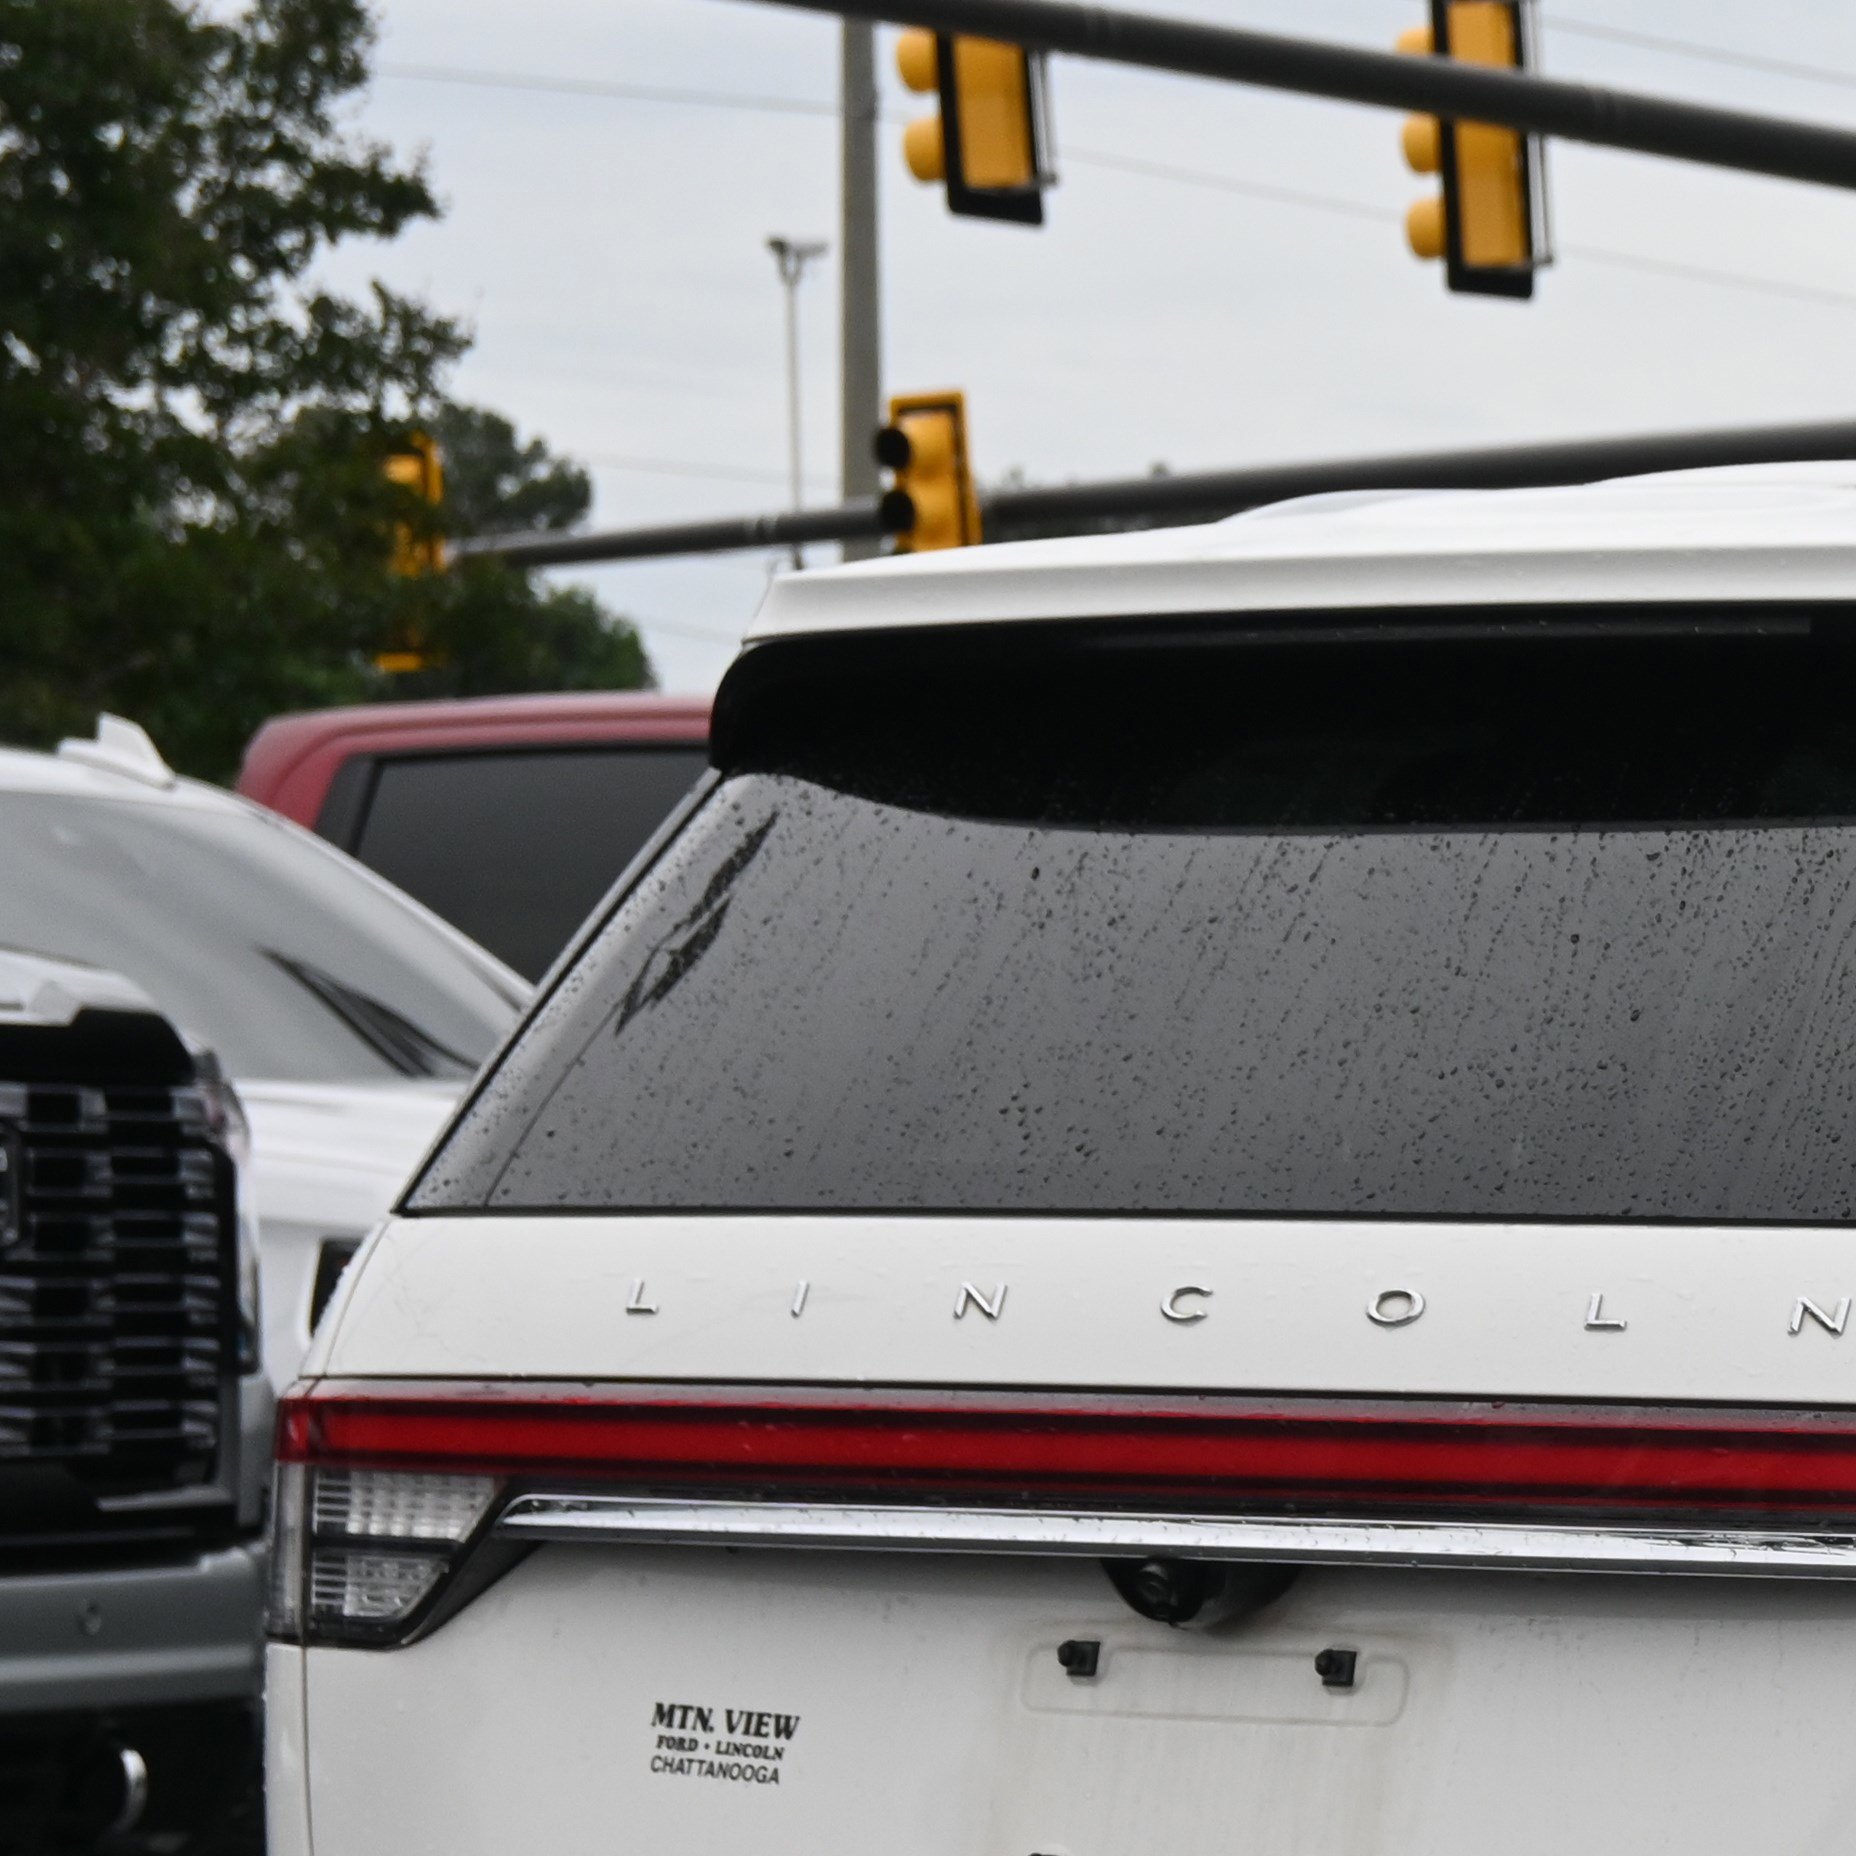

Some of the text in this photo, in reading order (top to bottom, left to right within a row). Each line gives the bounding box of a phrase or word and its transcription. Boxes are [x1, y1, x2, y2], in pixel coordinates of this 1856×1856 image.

[625, 1279, 1852, 1337] LINCOLN
[651, 1702, 800, 1740] MTN. VIEW
[657, 1735, 785, 1761] FORD LINCOLN
[651, 1755, 780, 1785] CHATTANOOGA
